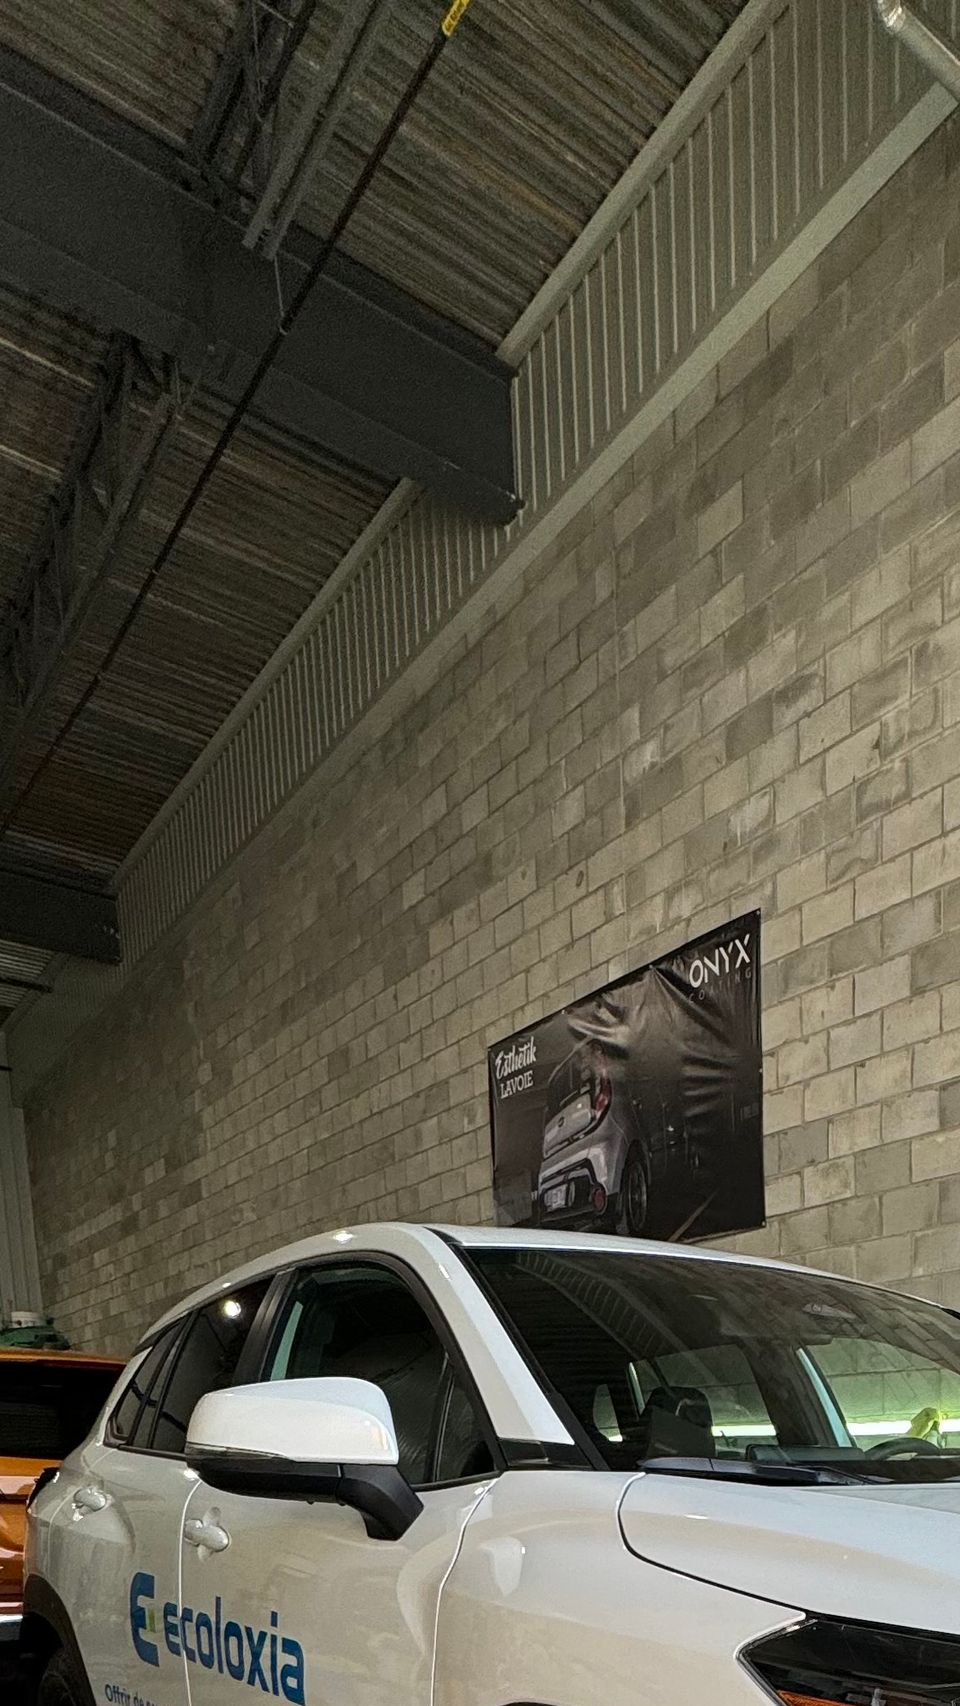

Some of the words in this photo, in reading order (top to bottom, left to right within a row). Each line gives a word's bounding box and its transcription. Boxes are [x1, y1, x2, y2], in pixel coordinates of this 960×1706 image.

[689, 933, 751, 988] ONYX
[495, 1036, 537, 1080] Esthetik
[500, 1070, 534, 1099] LAVOIE
[163, 1596, 306, 1706] ecoloxia
